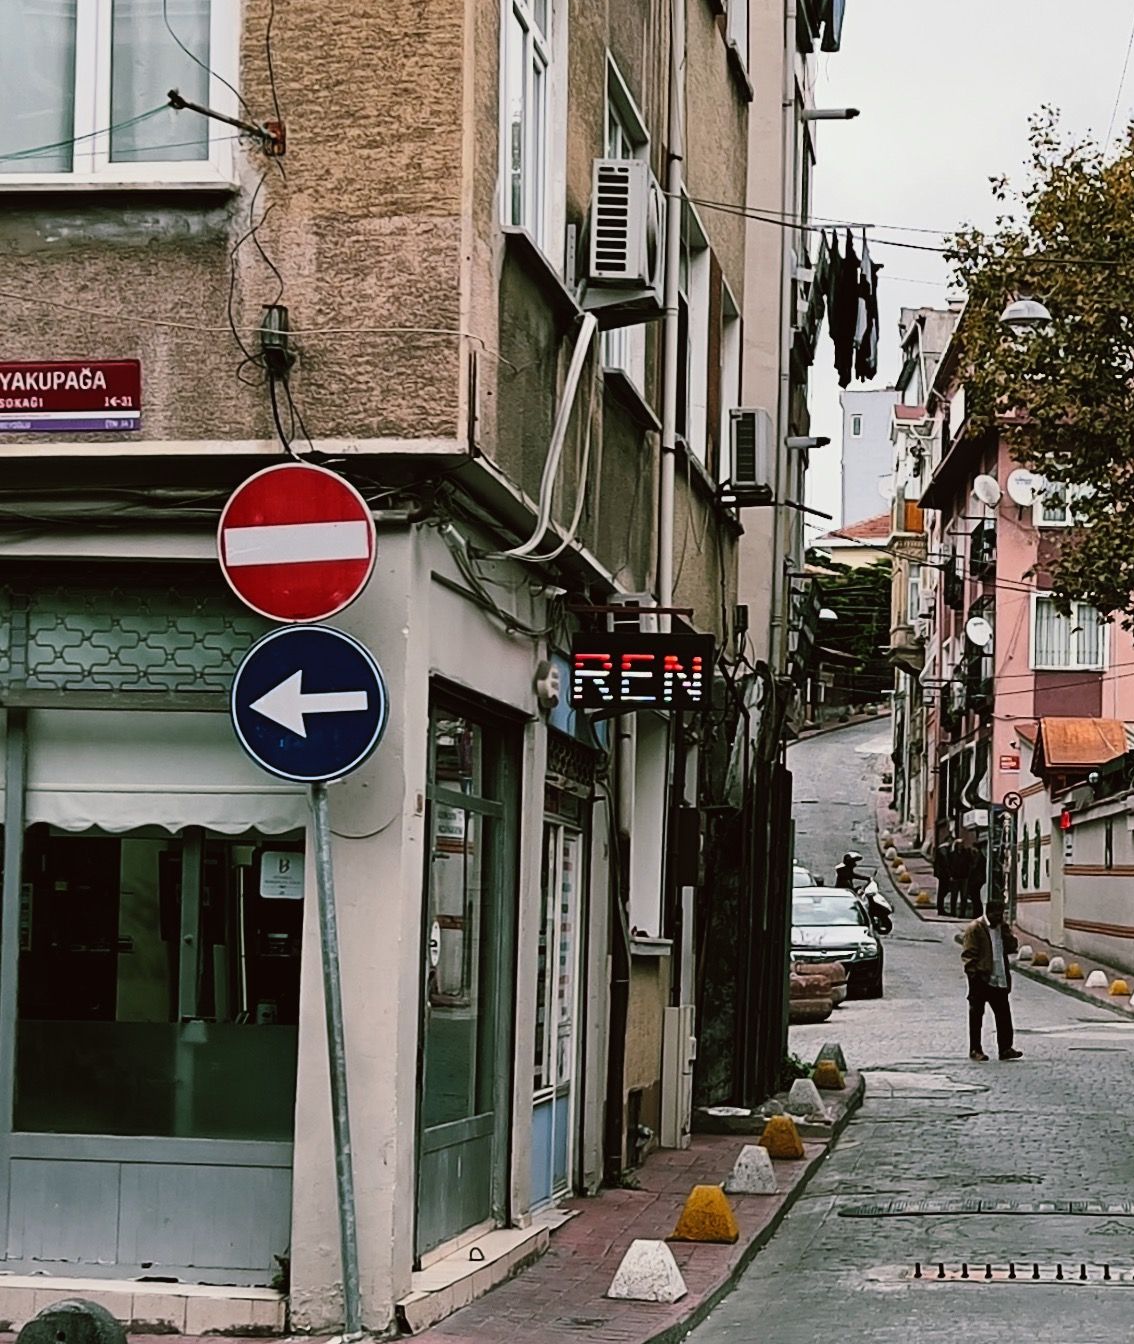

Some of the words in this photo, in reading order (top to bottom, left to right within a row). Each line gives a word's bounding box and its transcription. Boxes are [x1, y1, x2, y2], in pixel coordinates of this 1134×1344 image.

[0, 368, 106, 391] YAKUPAĞA
[0, 396, 44, 408] SOKAĞI
[574, 653, 702, 702] REN
